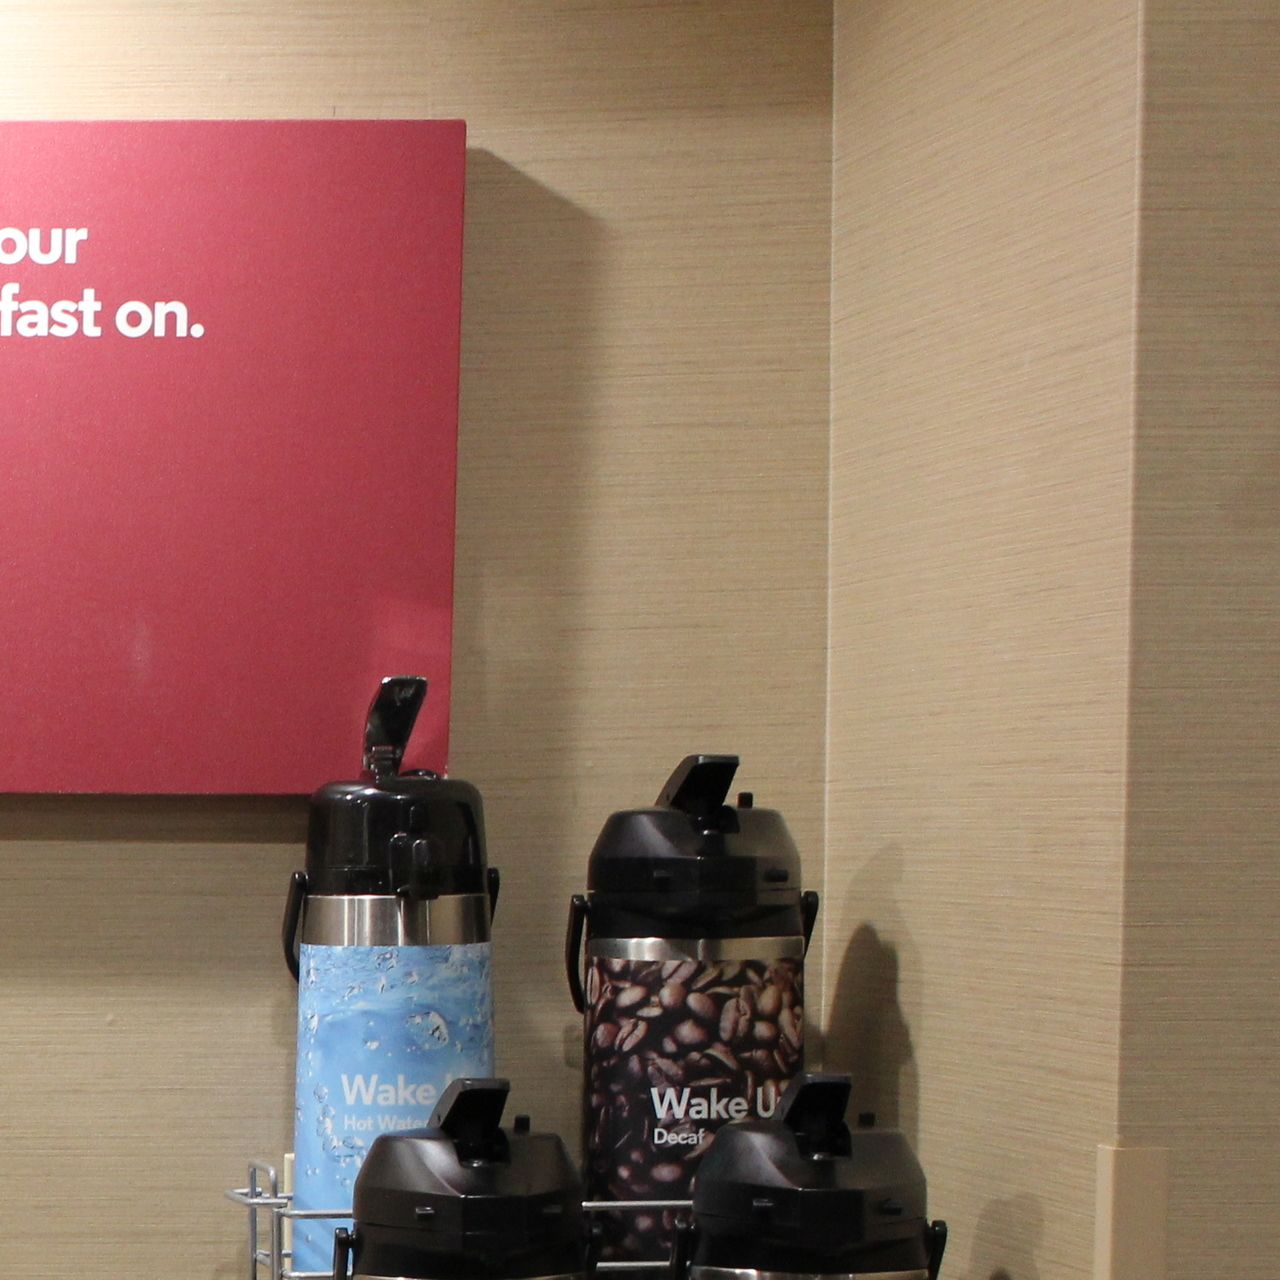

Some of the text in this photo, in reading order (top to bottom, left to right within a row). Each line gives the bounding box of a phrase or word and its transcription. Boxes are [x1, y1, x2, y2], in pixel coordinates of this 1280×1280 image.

[115, 300, 205, 338] on.
[341, 1073, 436, 1106] Wake
[650, 1086, 781, 1120] Wake U
[344, 1115, 373, 1131] Hot
[653, 1127, 705, 1145] Decaf
